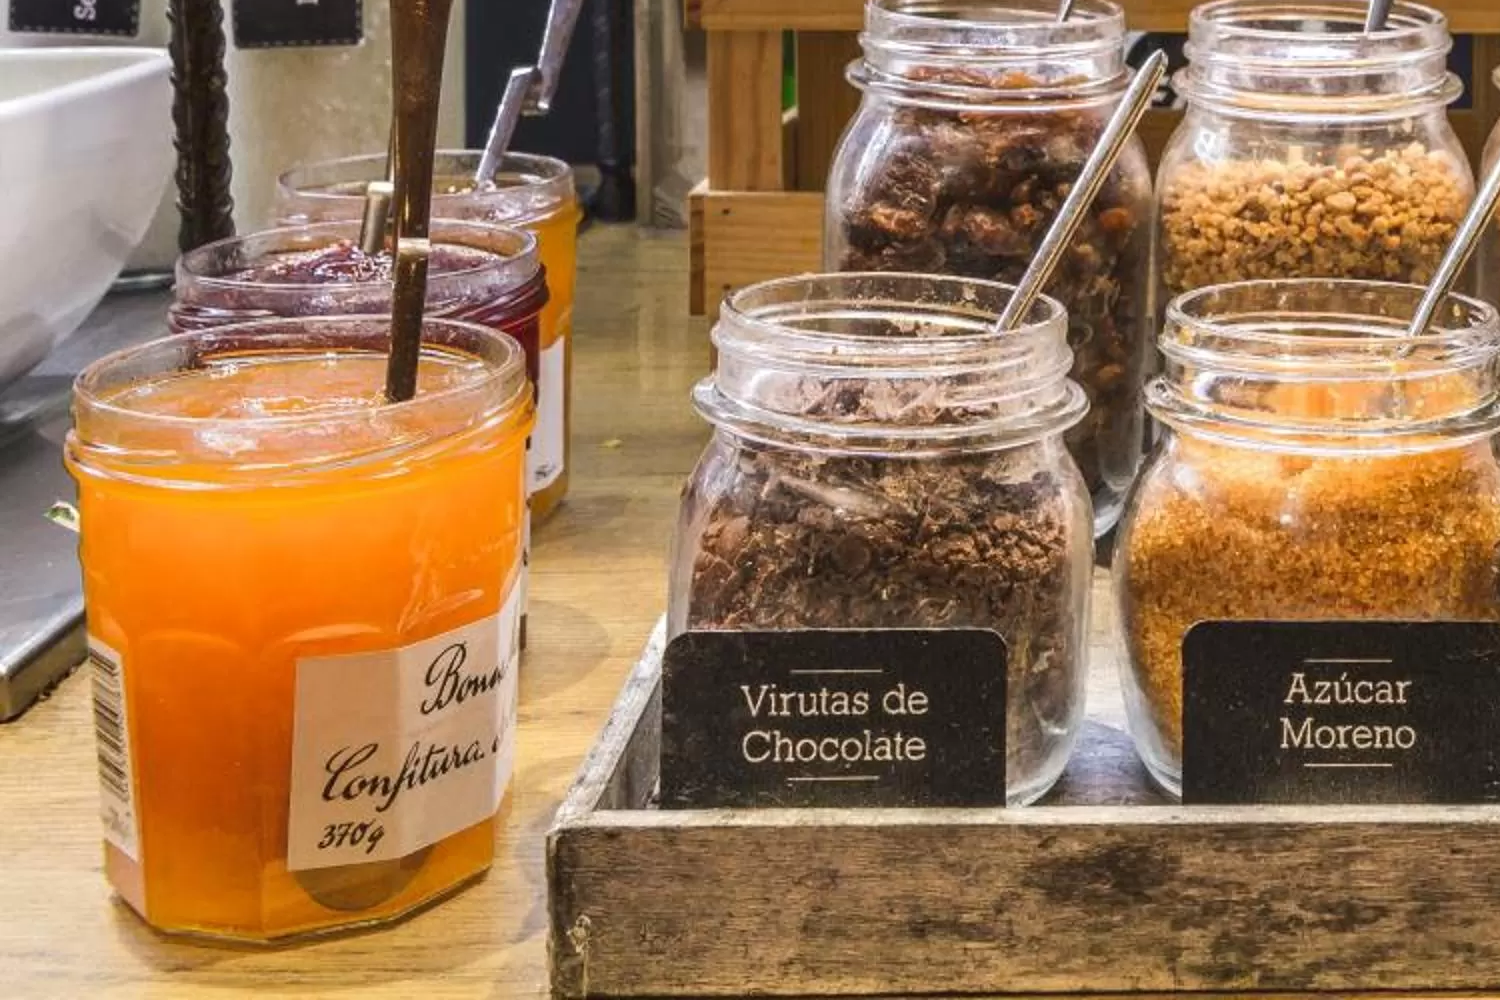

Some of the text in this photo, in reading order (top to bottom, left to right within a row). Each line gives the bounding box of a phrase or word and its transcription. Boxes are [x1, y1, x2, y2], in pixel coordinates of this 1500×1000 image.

[740, 682, 929, 718] Virutas de
[1283, 671, 1413, 705] Azúcar
[742, 729, 927, 763] Chocolate
[1279, 717, 1417, 750] Moreno
[322, 741, 485, 812] Confitura
[317, 818, 386, 855] 370g
